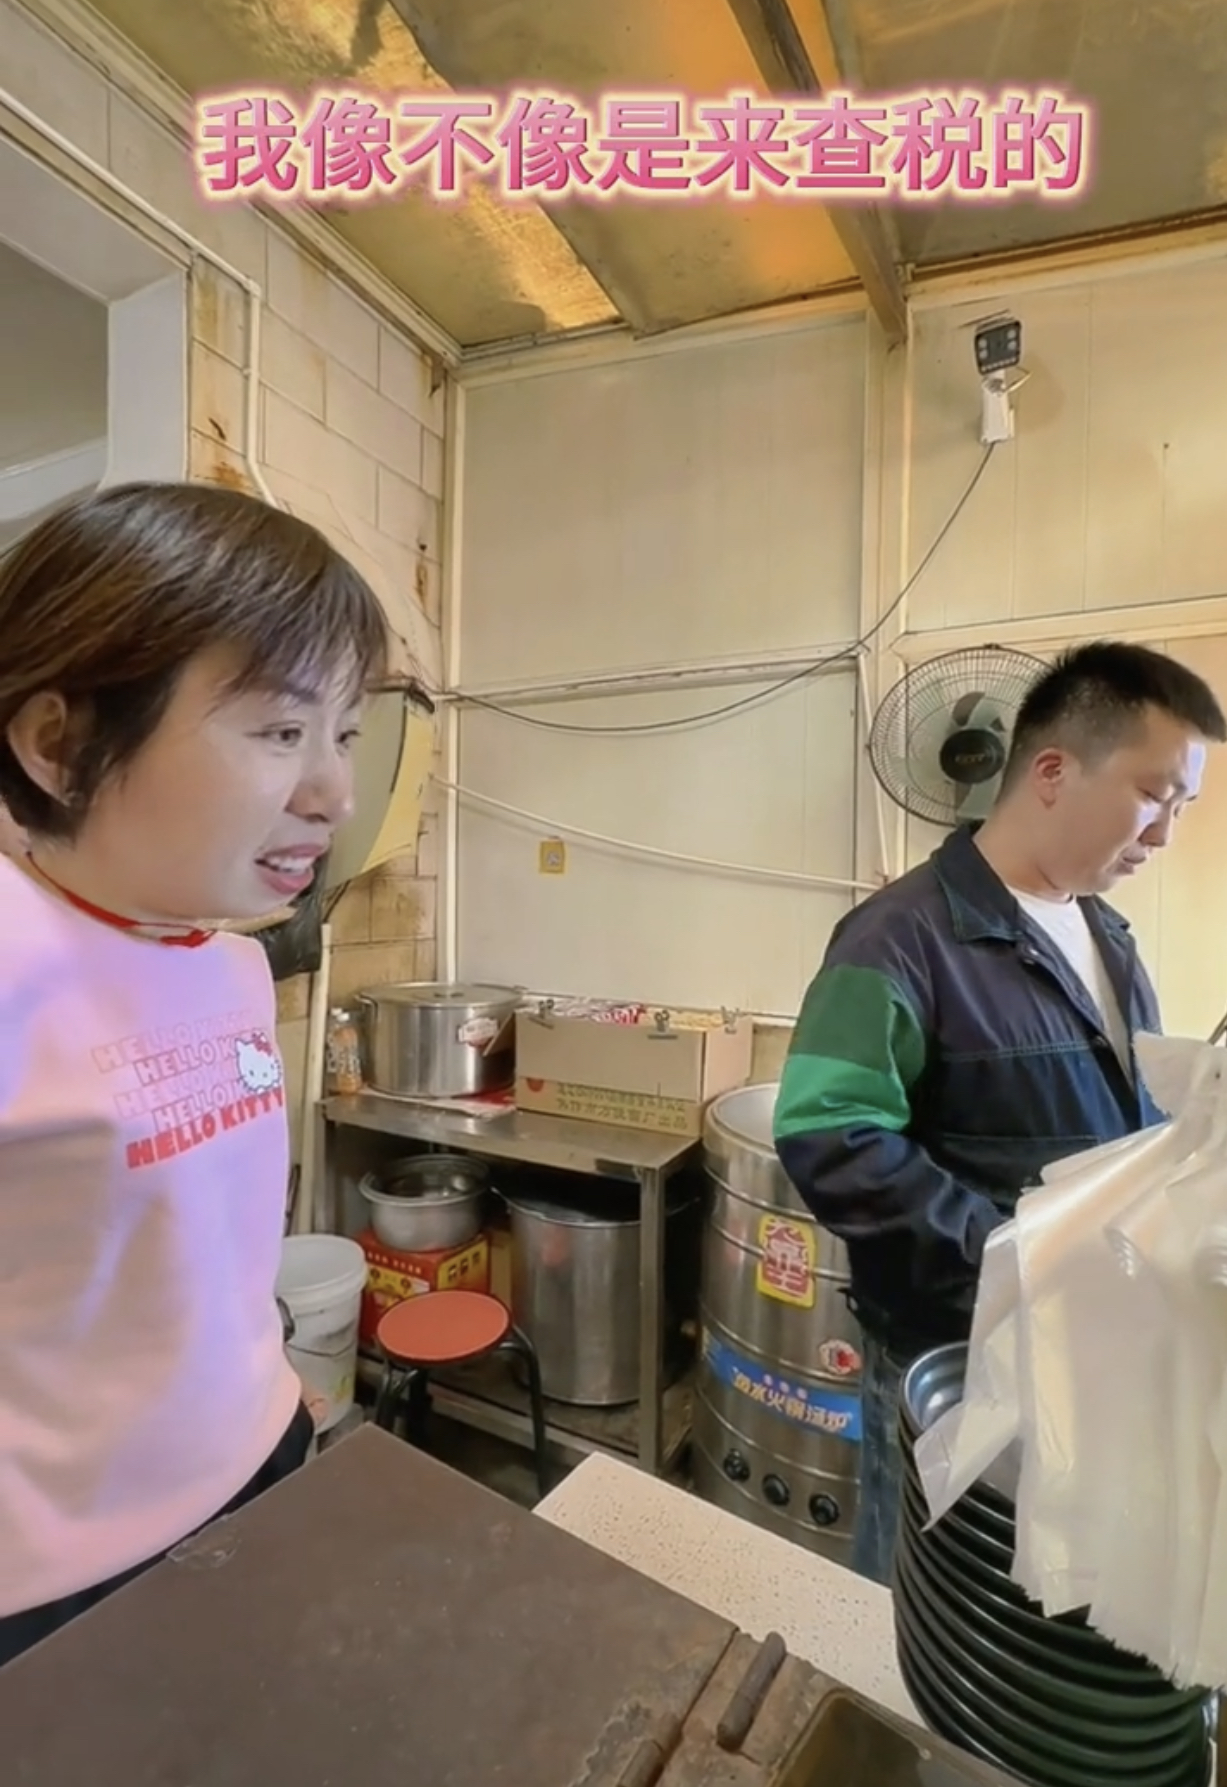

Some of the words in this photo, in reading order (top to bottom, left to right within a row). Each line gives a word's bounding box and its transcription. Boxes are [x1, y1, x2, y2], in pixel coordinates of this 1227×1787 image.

[133, 1040, 216, 1087] HELLO
[126, 1113, 217, 1170] HELLO
[220, 1085, 284, 1131] KITTY
[151, 1083, 227, 1134] HELLO
